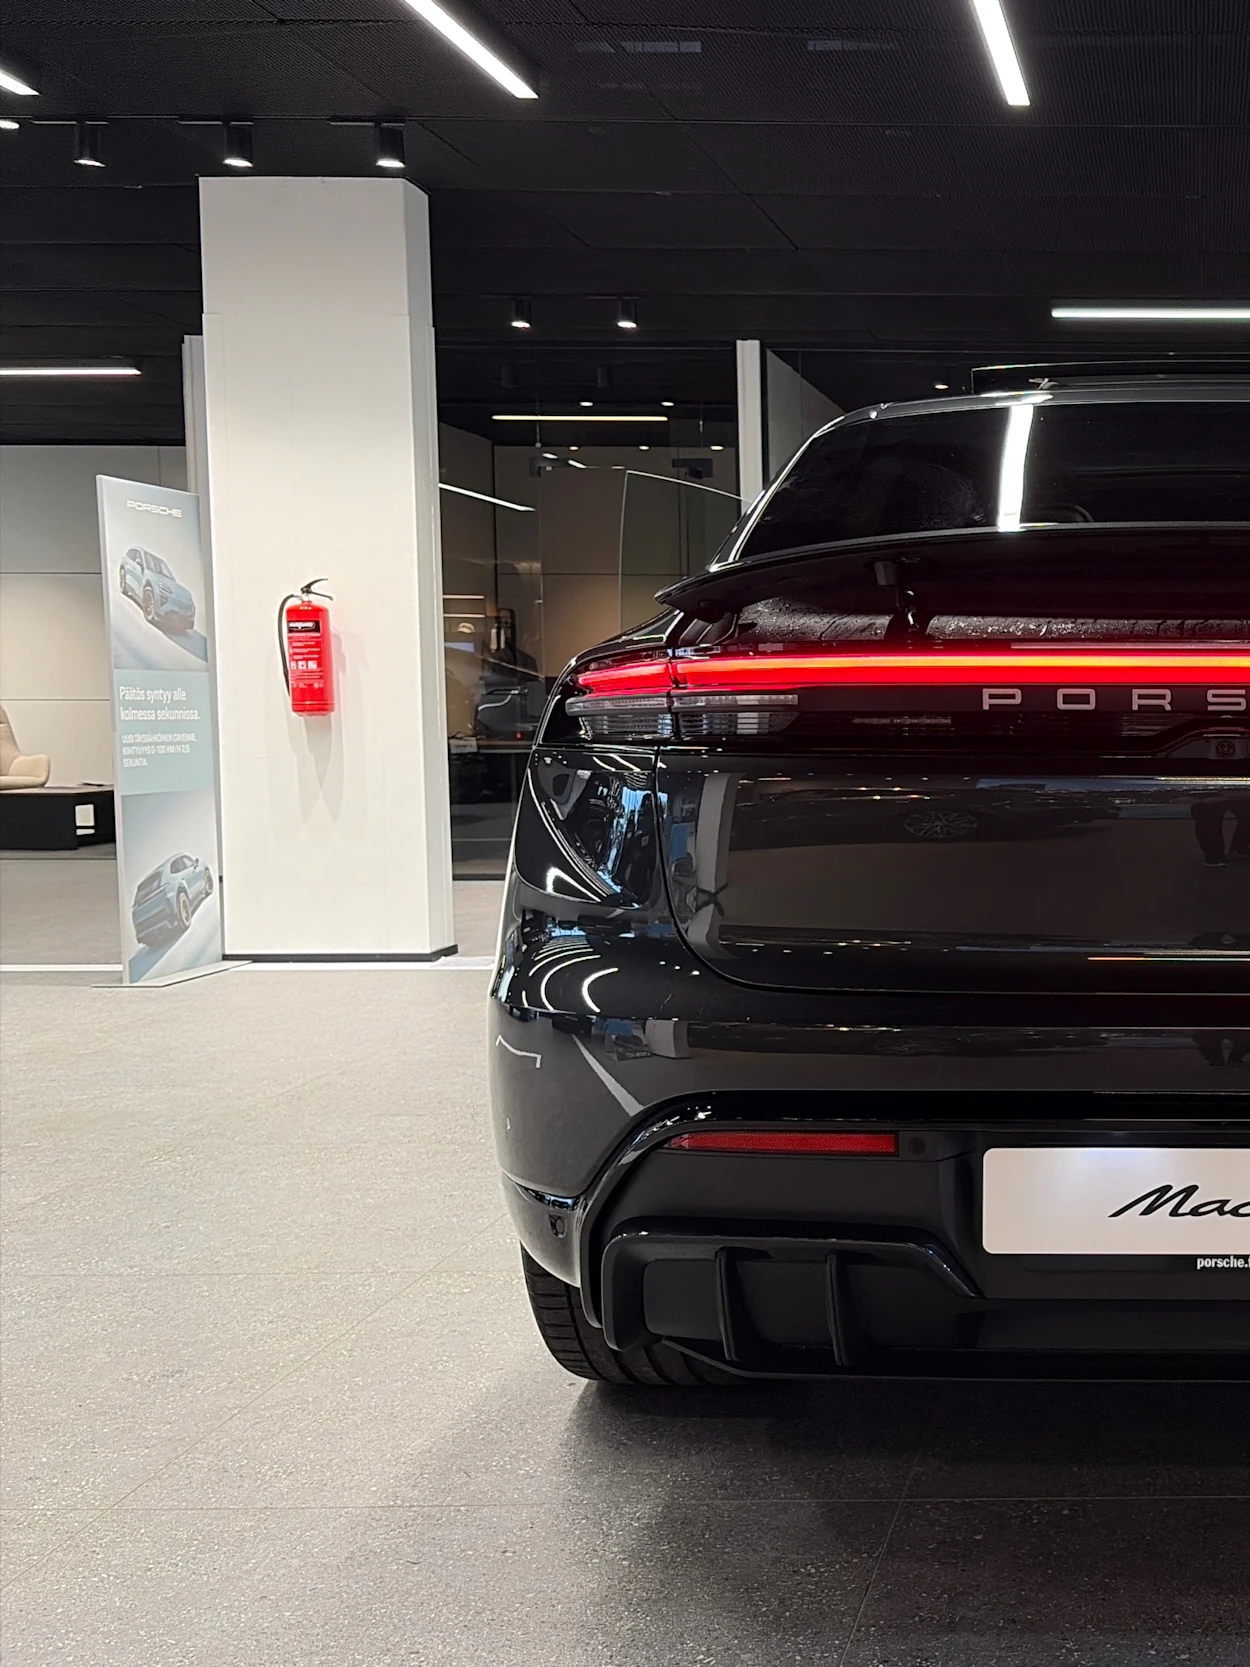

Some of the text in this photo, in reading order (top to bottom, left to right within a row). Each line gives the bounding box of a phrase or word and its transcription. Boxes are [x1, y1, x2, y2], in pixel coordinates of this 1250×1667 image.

[126, 499, 183, 518] PORSCHE
[119, 686, 187, 704] Päätös syntyy alle
[120, 706, 201, 721] kolmessa sekunnissa.
